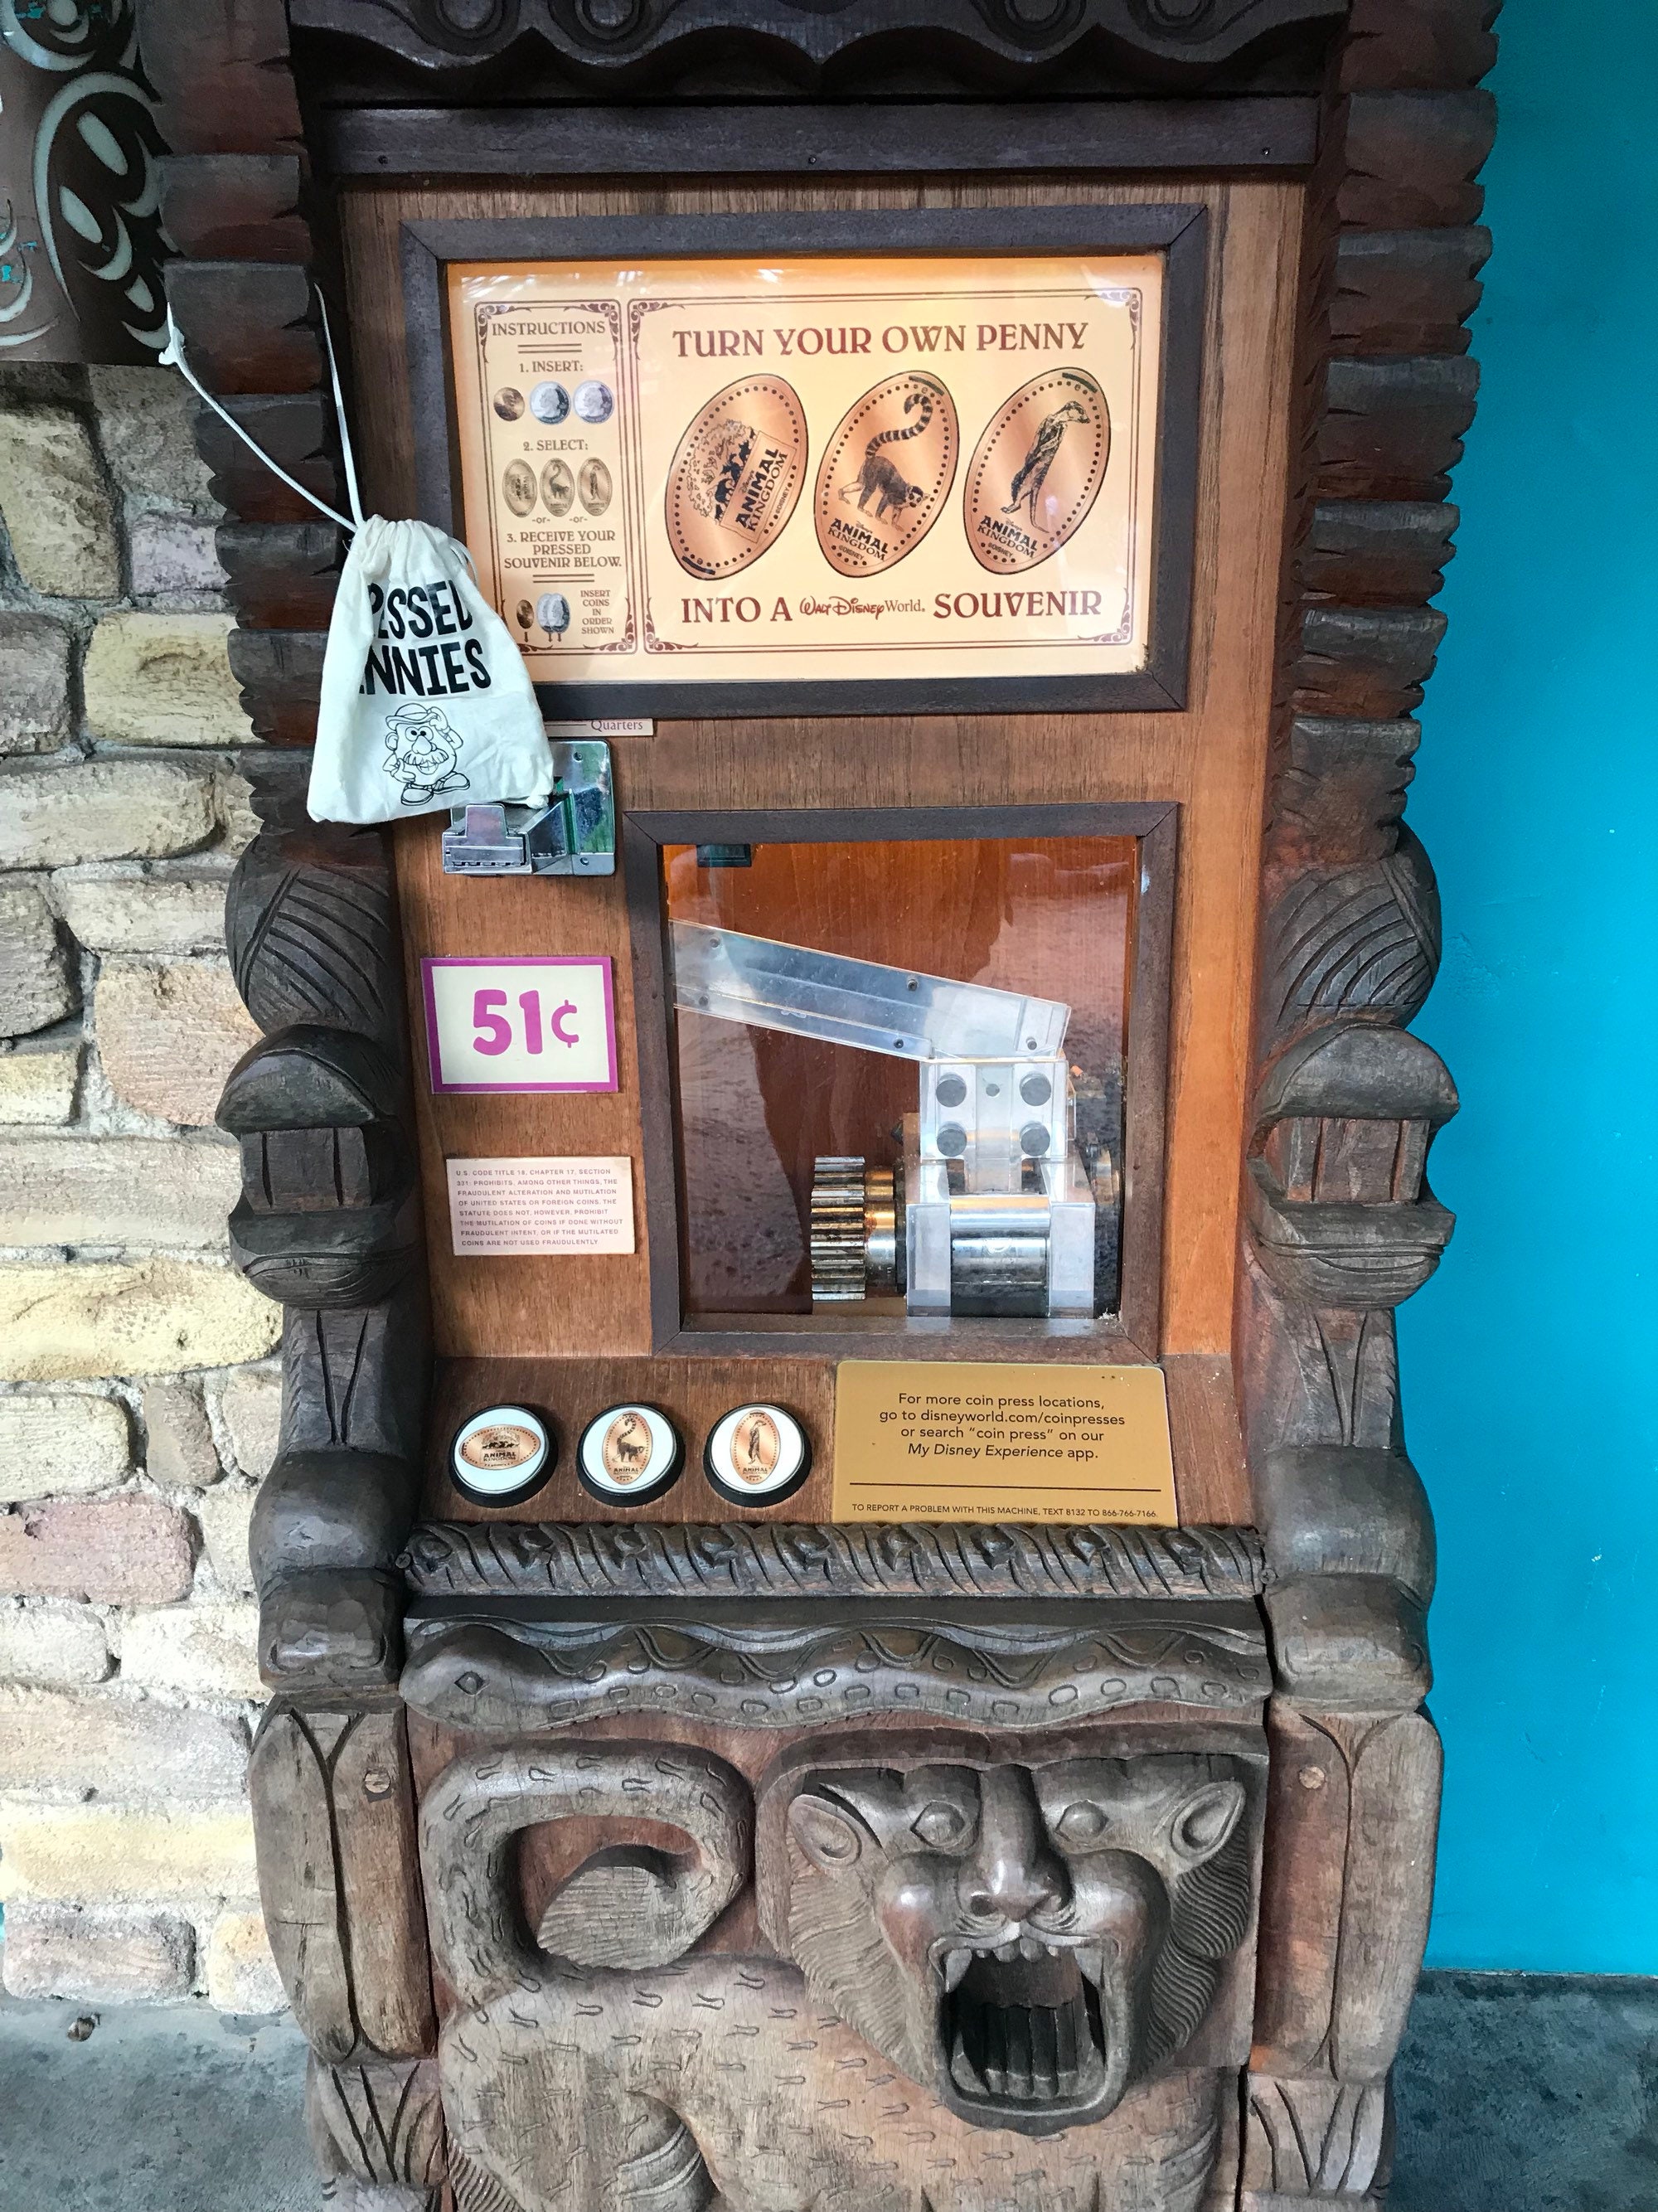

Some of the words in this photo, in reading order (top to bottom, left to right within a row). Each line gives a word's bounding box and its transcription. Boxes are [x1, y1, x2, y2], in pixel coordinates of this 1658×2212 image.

[492, 321, 606, 336] INSTRUCTIONS
[672, 329, 764, 358] TURN
[773, 327, 872, 357] YOUR
[882, 324, 967, 354] OWN
[977, 321, 1089, 352] PENNY
[520, 363, 529, 372] 1.
[532, 361, 584, 372] INSERT:
[523, 442, 534, 451] 2.
[537, 439, 589, 451] SELECT:
[735, 449, 779, 528] ANIMAL
[747, 452, 788, 532] KINGDOM
[507, 533, 516, 543] 3.
[520, 531, 574, 542] RECEIVE
[578, 530, 616, 541] YOUR
[831, 517, 888, 554] ANIMAL
[981, 515, 1038, 551] ANIMAL
[533, 544, 591, 555] PRESSED
[828, 526, 885, 561] KINGDOM
[977, 525, 1035, 558] KINGDOM
[504, 557, 570, 569] SOUVENIR
[574, 556, 622, 567] BELOW.
[580, 589, 610, 598] INSERT
[583, 599, 610, 607] COINS
[680, 595, 762, 625] INTO
[770, 595, 793, 623] A
[934, 590, 1101, 619] SOUVENIR
[591, 720, 643, 732] Quarters
[473, 988, 579, 1056] 51¢
[899, 1393, 922, 1404] For
[926, 1395, 962, 1405] more
[965, 1395, 993, 1406] coin
[998, 1397, 1035, 1409] press
[1039, 1395, 1105, 1409] locations,
[880, 1411, 898, 1423] go
[902, 1410, 916, 1420] to
[920, 1409, 1125, 1428] disneyworld.com/coinpresses
[901, 1428, 915, 1437] or
[919, 1426, 964, 1438] search
[1059, 1431, 1076, 1441] on
[1081, 1432, 1104, 1441] our
[908, 1443, 930, 1458] My
[933, 1443, 981, 1459] Disney
[985, 1444, 1064, 1460] Experience
[1067, 1448, 1098, 1462] app.
[910, 1505, 950, 1513] PROBLEM
[997, 1506, 1040, 1516] MACHINE,
[1066, 1508, 1085, 1516] 8132
[1102, 1509, 1157, 1518] 866-766-7166.
